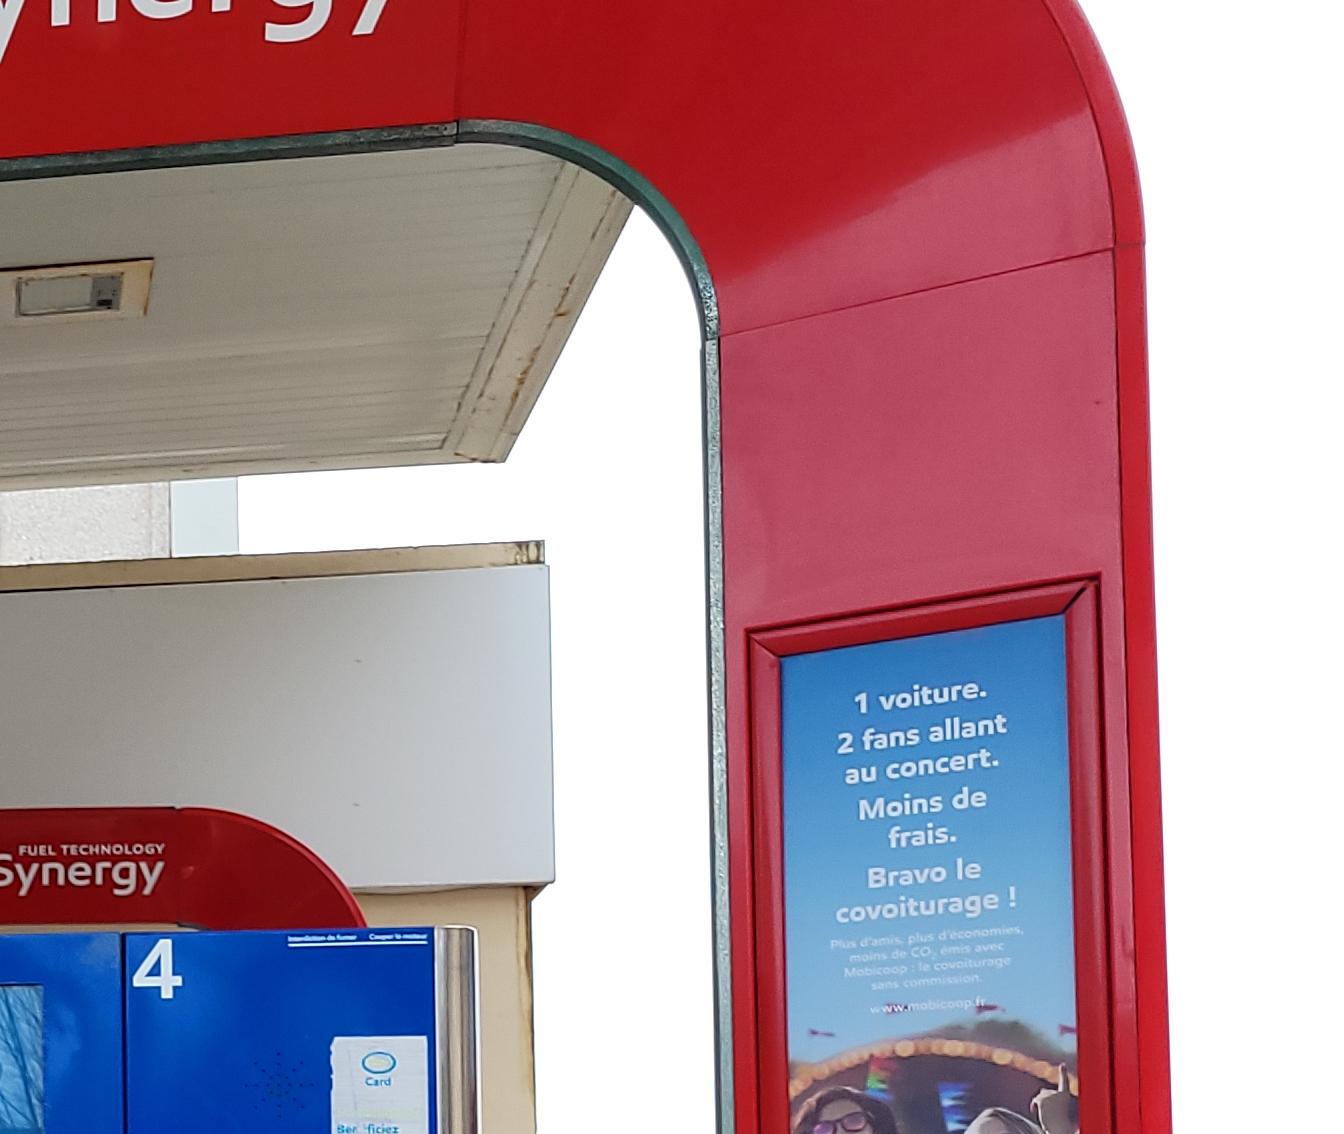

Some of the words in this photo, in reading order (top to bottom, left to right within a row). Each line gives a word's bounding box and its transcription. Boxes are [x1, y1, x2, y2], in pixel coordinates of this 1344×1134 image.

[855, 693, 868, 713] 1
[879, 682, 987, 711] voiture.
[837, 732, 853, 754] 2
[862, 726, 920, 751] fans
[929, 714, 1007, 742] allant
[844, 764, 877, 785] au
[886, 748, 999, 780] concert.
[859, 793, 943, 820] Moins
[952, 787, 987, 810] de
[18, 845, 55, 856] FUEL
[60, 843, 165, 856] TECHNOLOGY
[889, 823, 957, 849] frais.
[868, 863, 947, 889] Bravo
[956, 858, 981, 881] le
[836, 888, 999, 924] covoiturage
[1009, 886, 1016, 907] !
[830, 939, 857, 950] Plus
[908, 932, 934, 946] plus
[849, 951, 887, 963] moins
[891, 949, 907, 960] de
[974, 941, 1004, 953] avec
[133, 938, 183, 999] 4
[844, 964, 907, 978] Mobicoop
[934, 955, 1011, 972] covoiturage
[871, 980, 899, 991] sans
[365, 1077, 391, 1087] Card
